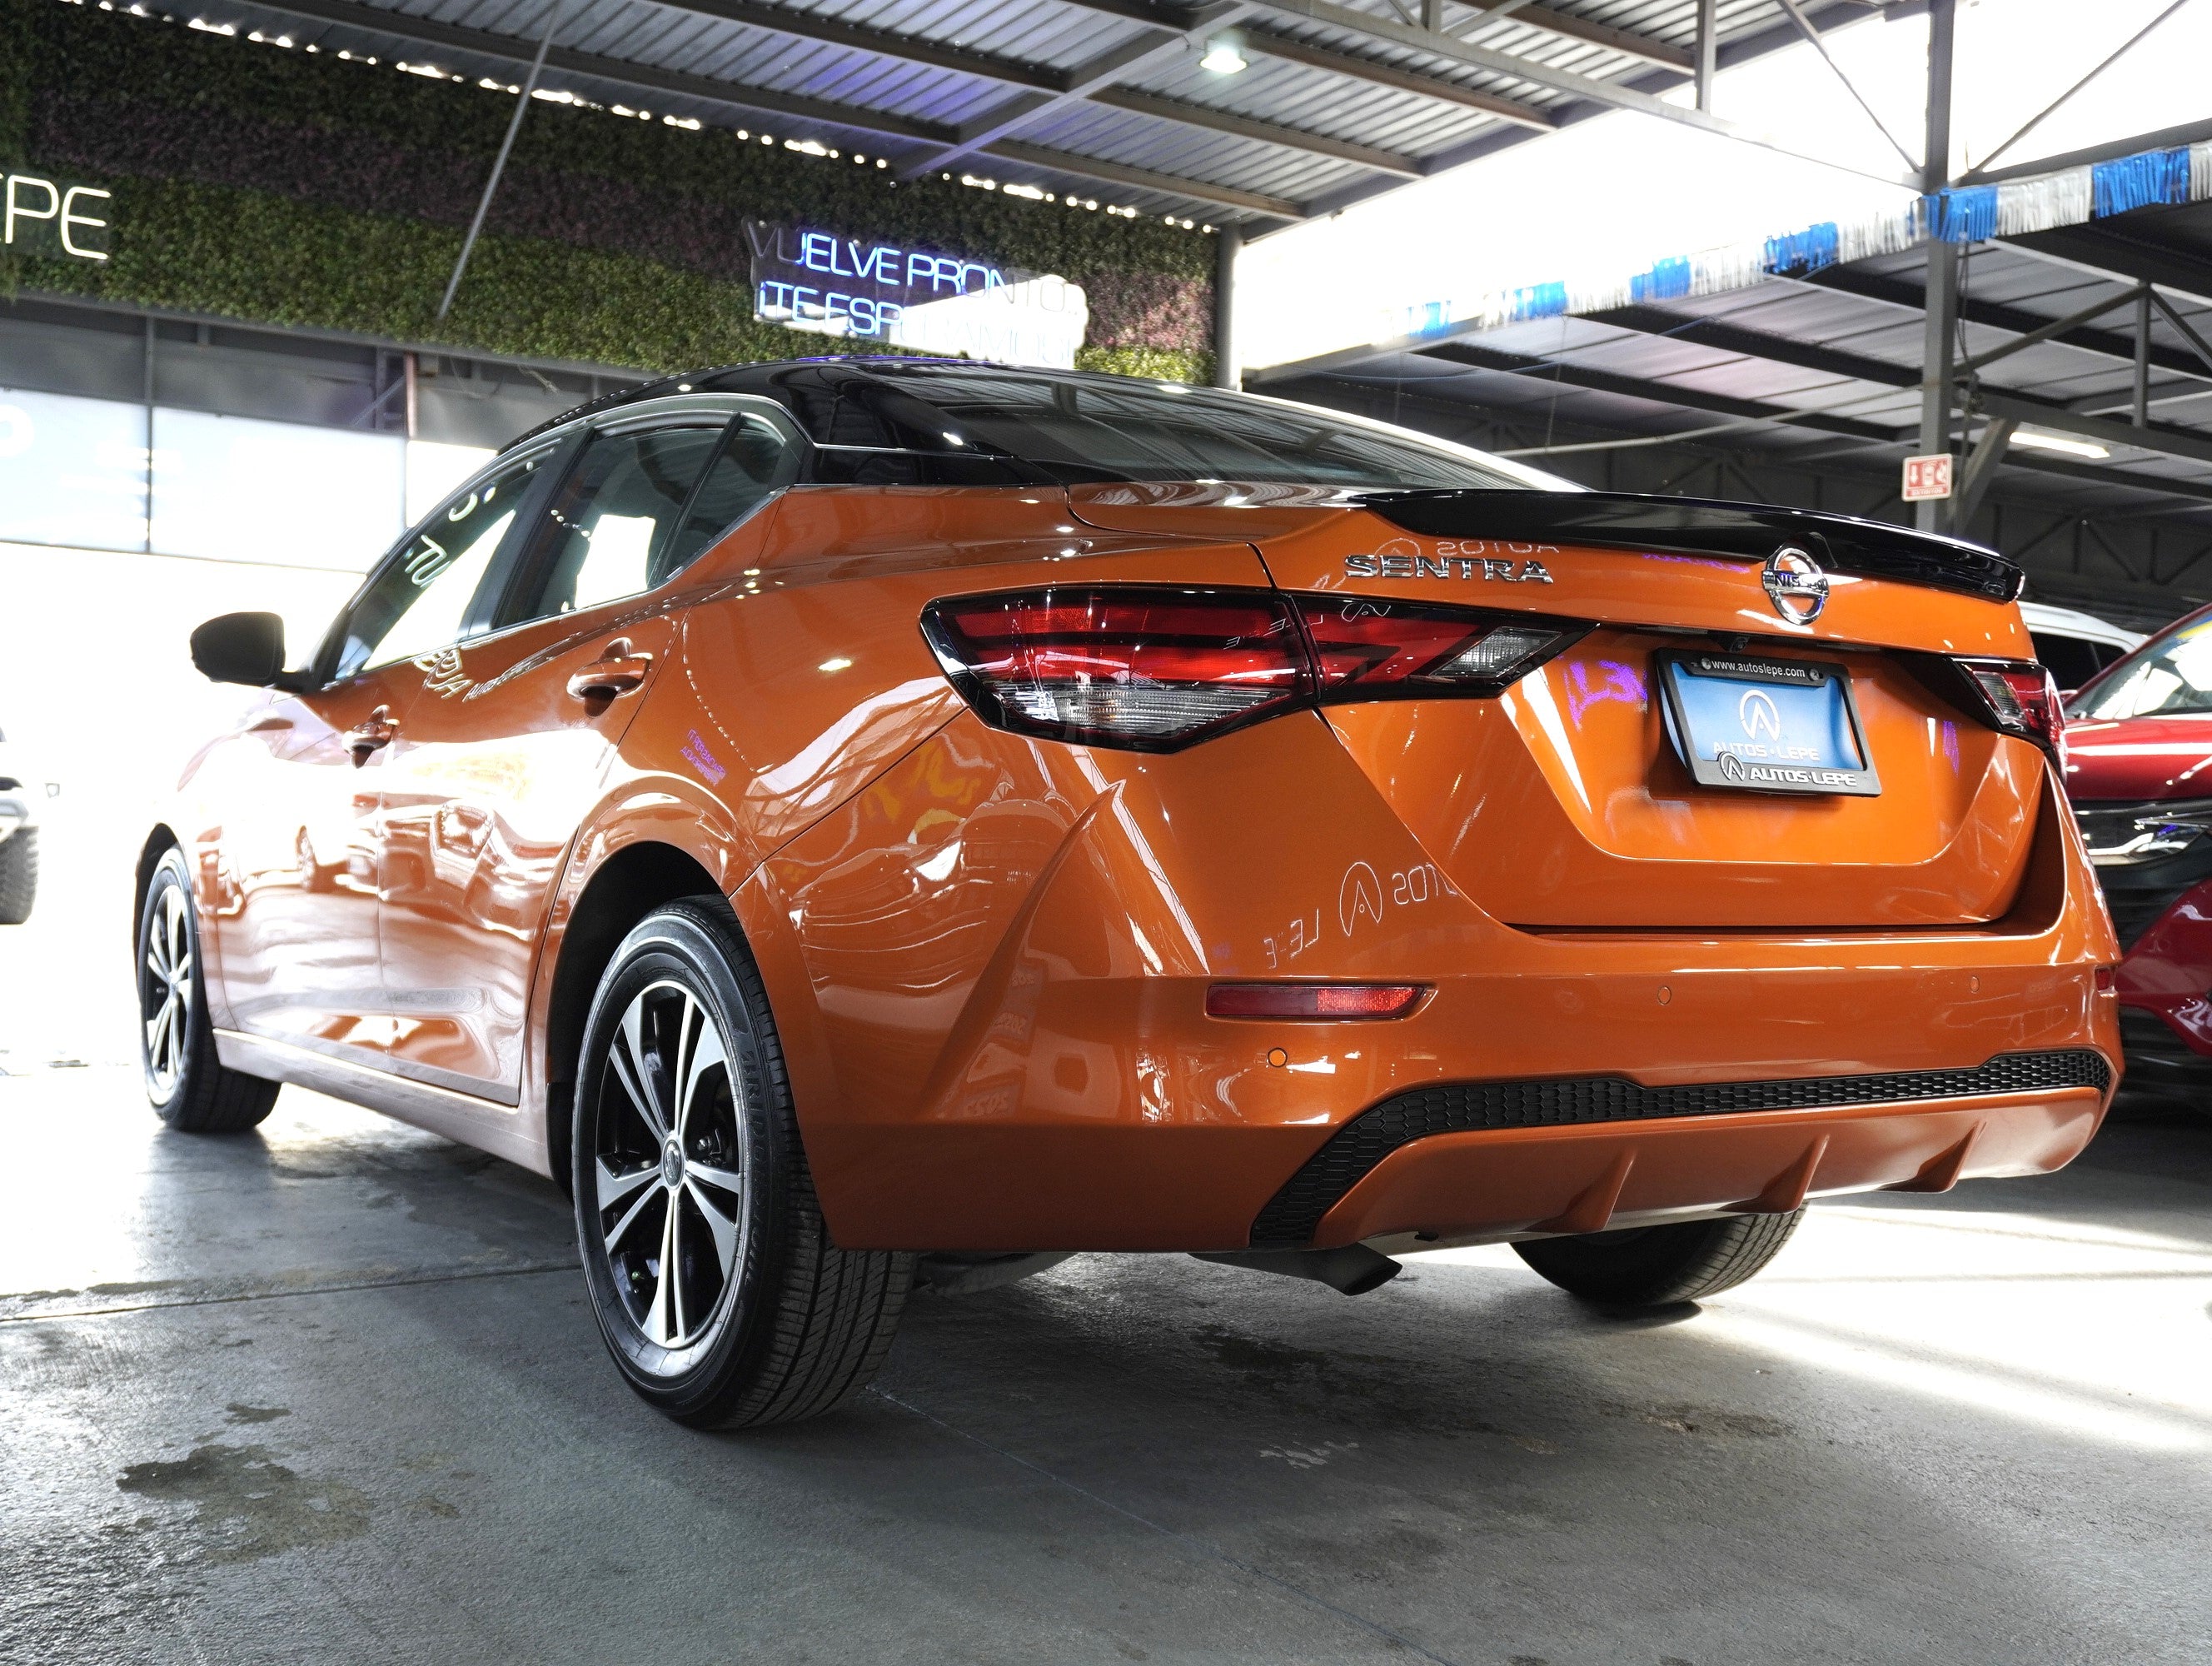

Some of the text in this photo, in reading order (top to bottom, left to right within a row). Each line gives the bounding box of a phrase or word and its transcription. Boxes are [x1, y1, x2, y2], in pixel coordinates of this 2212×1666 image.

[0, 172, 112, 260] PE
[747, 221, 902, 286] VUELVE
[1344, 555, 1554, 583] SENTRA
[1711, 660, 1806, 678] www.autoslepe.com
